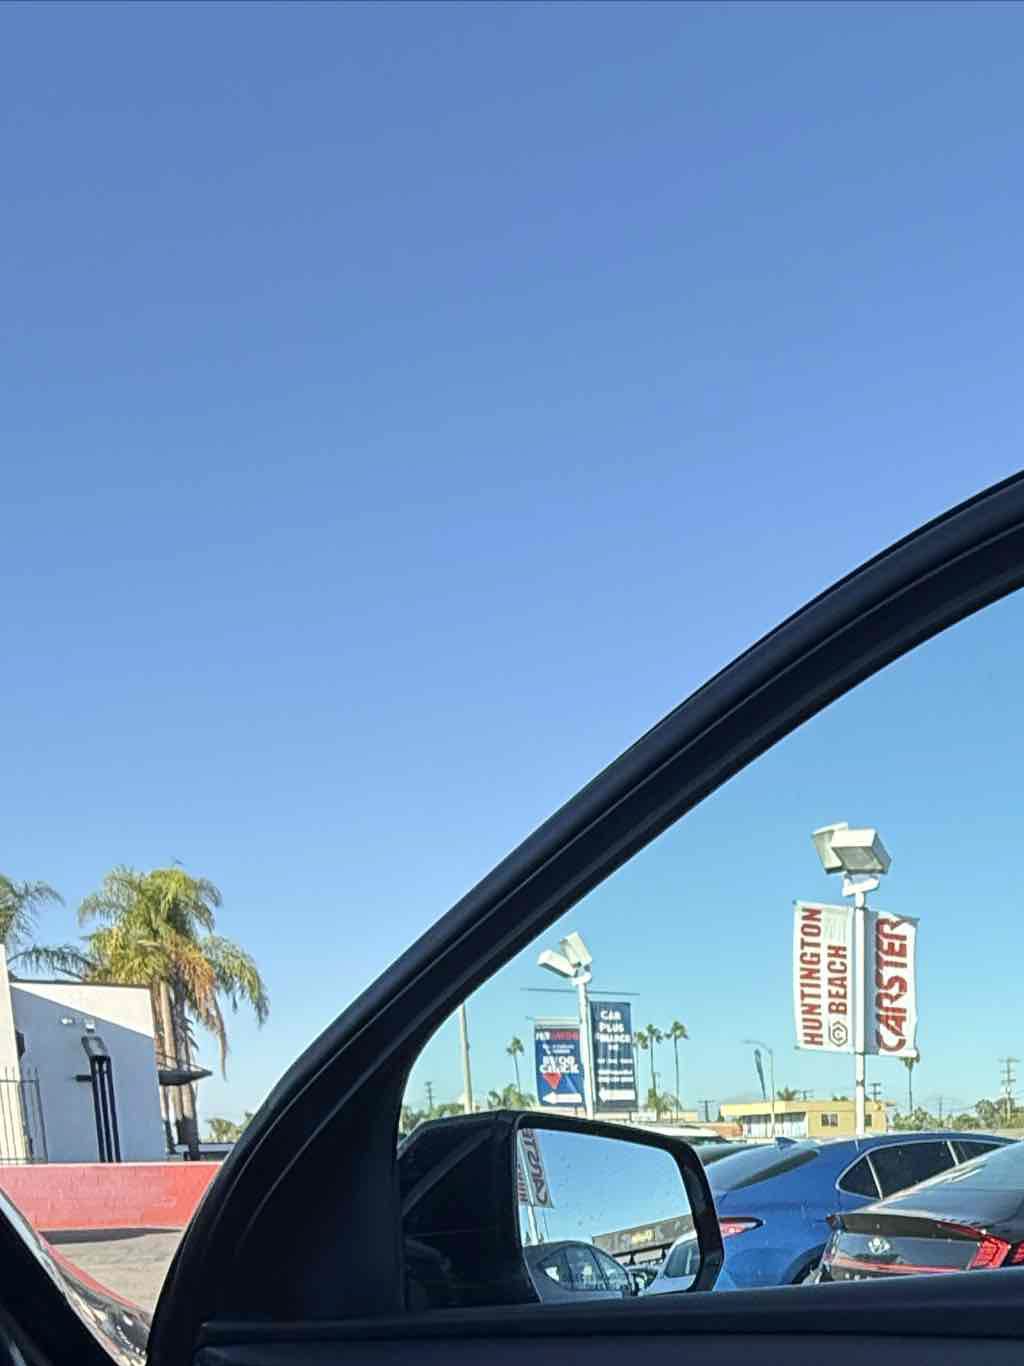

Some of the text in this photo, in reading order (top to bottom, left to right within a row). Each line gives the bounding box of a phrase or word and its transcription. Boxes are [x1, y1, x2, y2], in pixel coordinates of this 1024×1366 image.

[600, 1009, 621, 1020] CAR
[800, 908, 823, 1046] HUNTINGTON
[827, 944, 847, 1015] BEACH
[875, 917, 908, 1052] CARSTER
